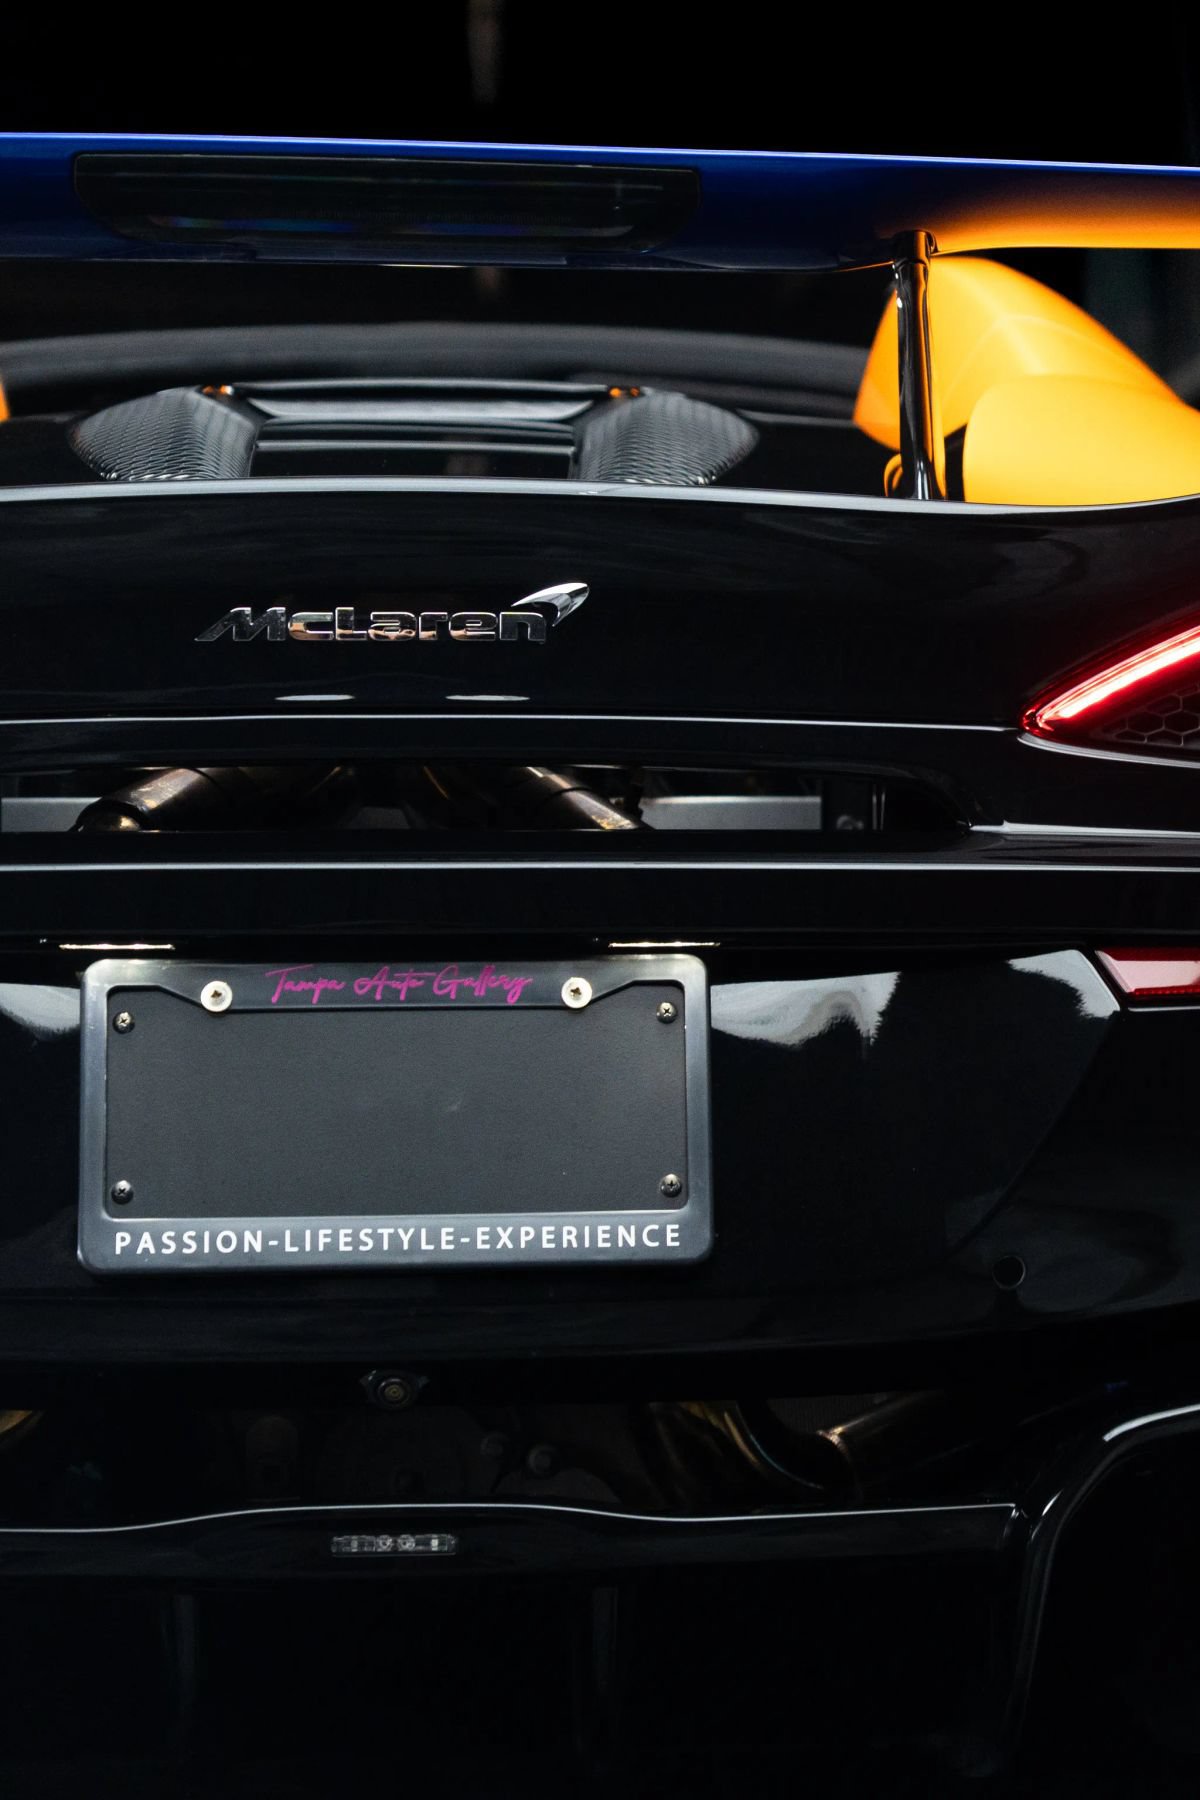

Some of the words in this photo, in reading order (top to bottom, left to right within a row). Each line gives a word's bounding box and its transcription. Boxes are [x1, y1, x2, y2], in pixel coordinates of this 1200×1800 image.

[194, 606, 547, 642] McLaren
[431, 964, 534, 1005] Gallery
[114, 1223, 682, 1255] PASSION-LIFESTYLE-EXPERIENCE
